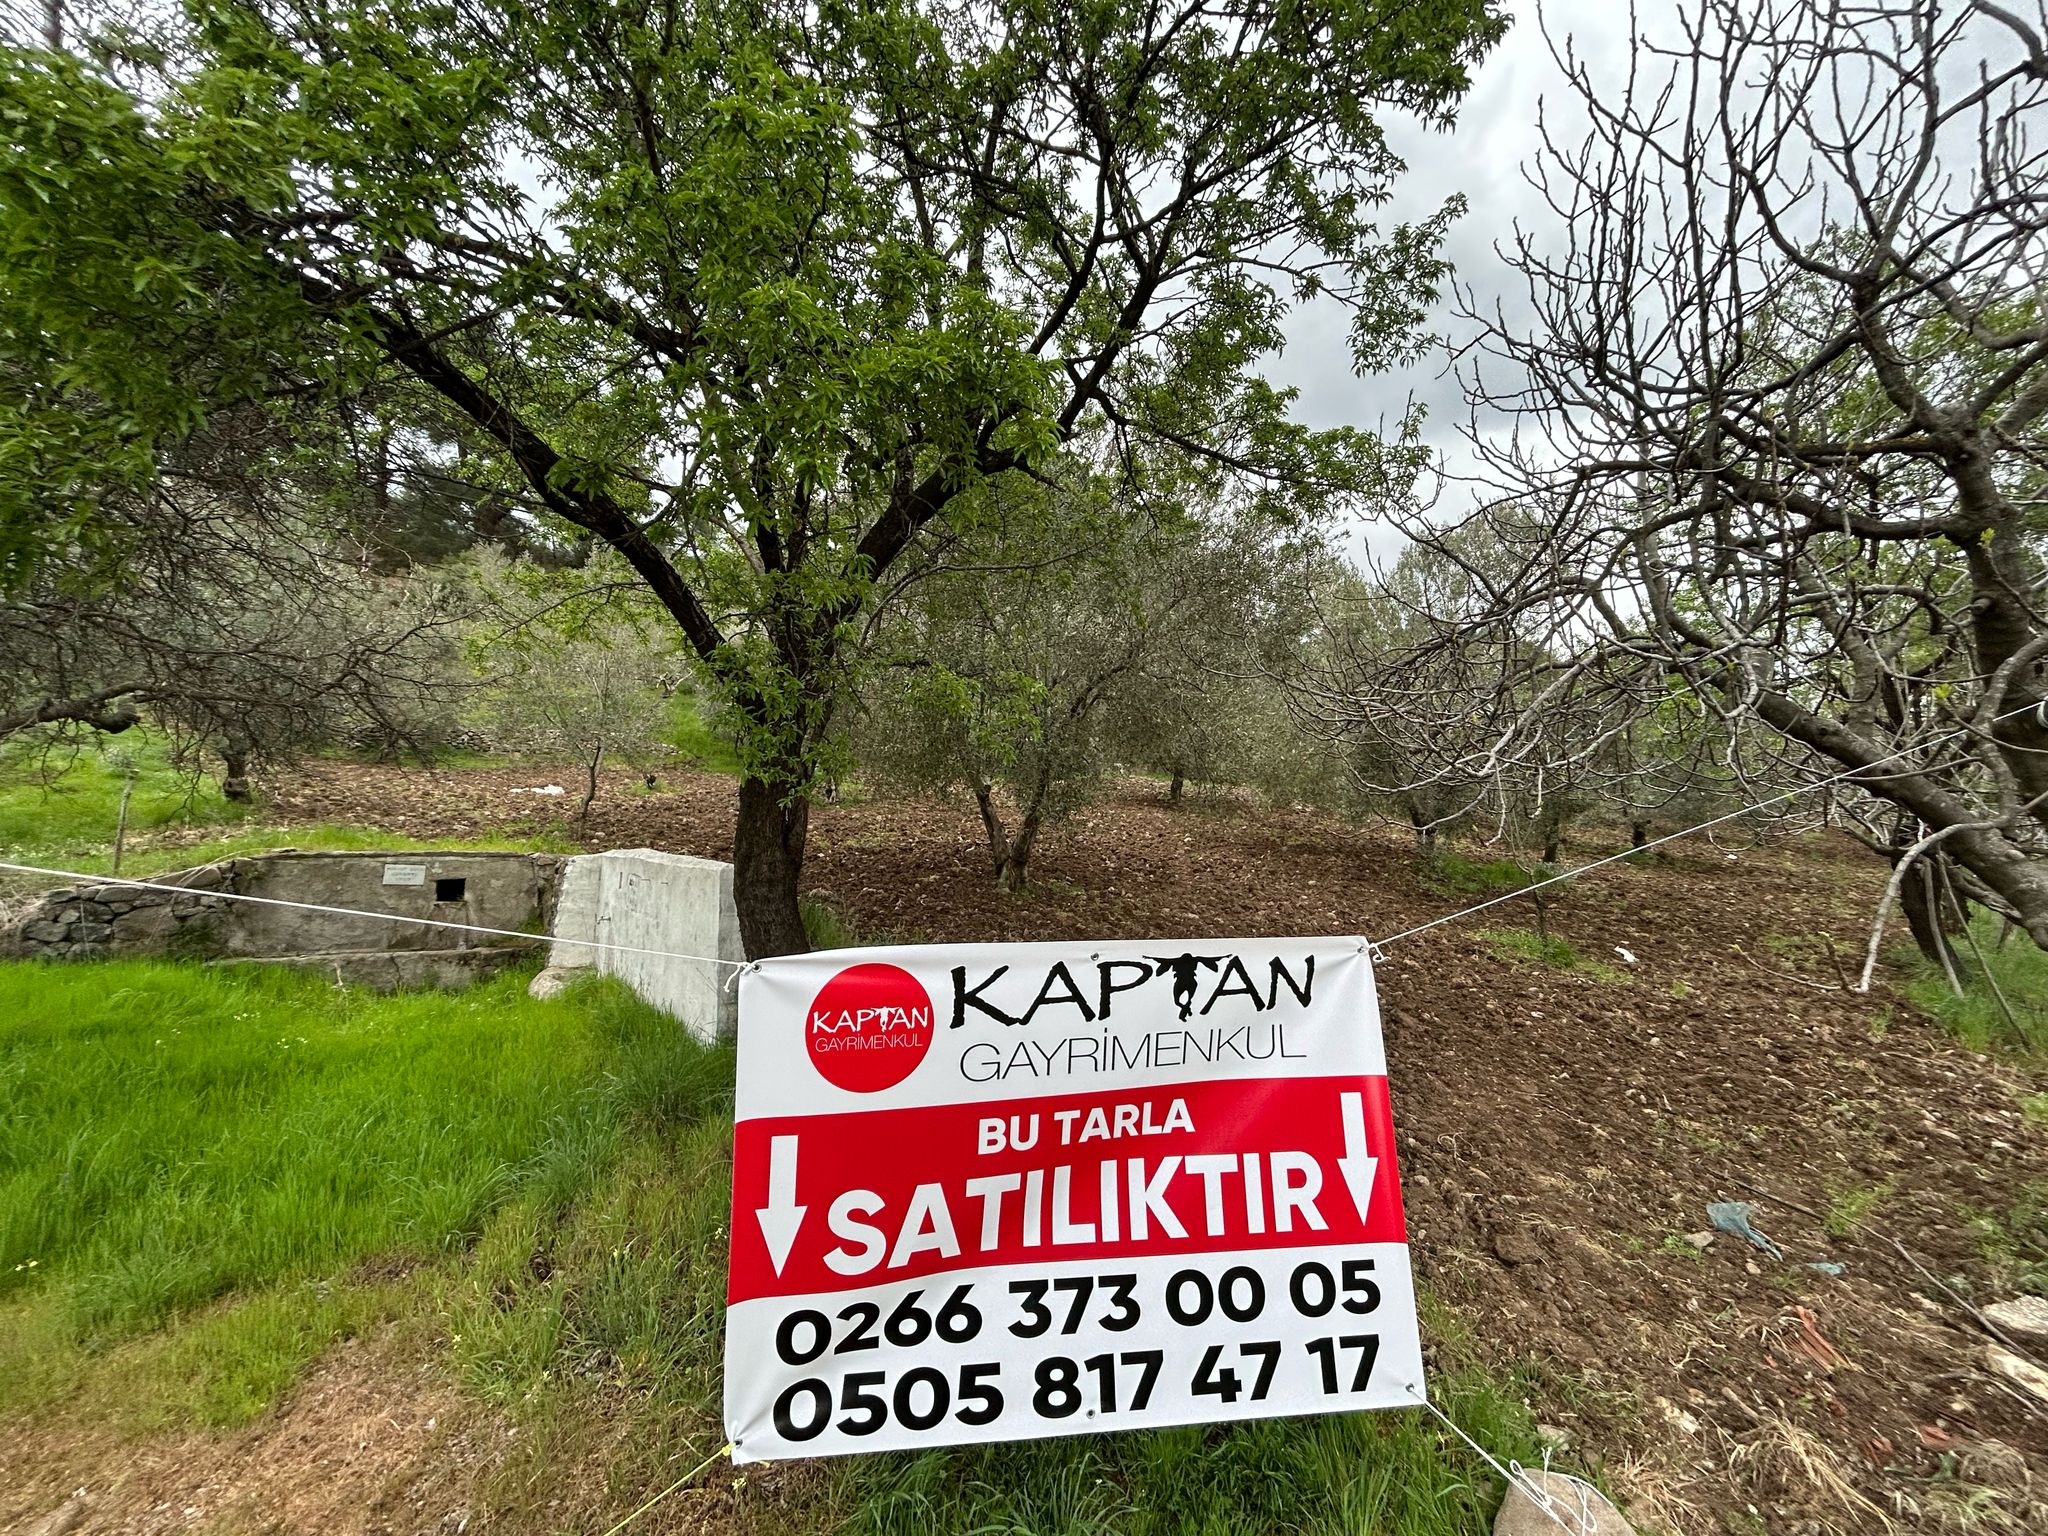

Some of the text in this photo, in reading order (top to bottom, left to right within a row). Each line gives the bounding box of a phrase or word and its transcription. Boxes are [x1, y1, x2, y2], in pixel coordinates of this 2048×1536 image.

[812, 1006, 929, 1033] KAPTAN
[949, 953, 1316, 1029] KAPTAN
[815, 1033, 923, 1052] GAYRİMENKUL
[959, 1024, 1307, 1082] GAYRİMENKUL
[977, 1098, 1195, 1155] BU TARLA
[823, 1151, 1329, 1276] SATILIKTIR
[776, 1259, 1381, 1365] 0266 373 00 05
[773, 1333, 1380, 1442] 0505 817 47 17
